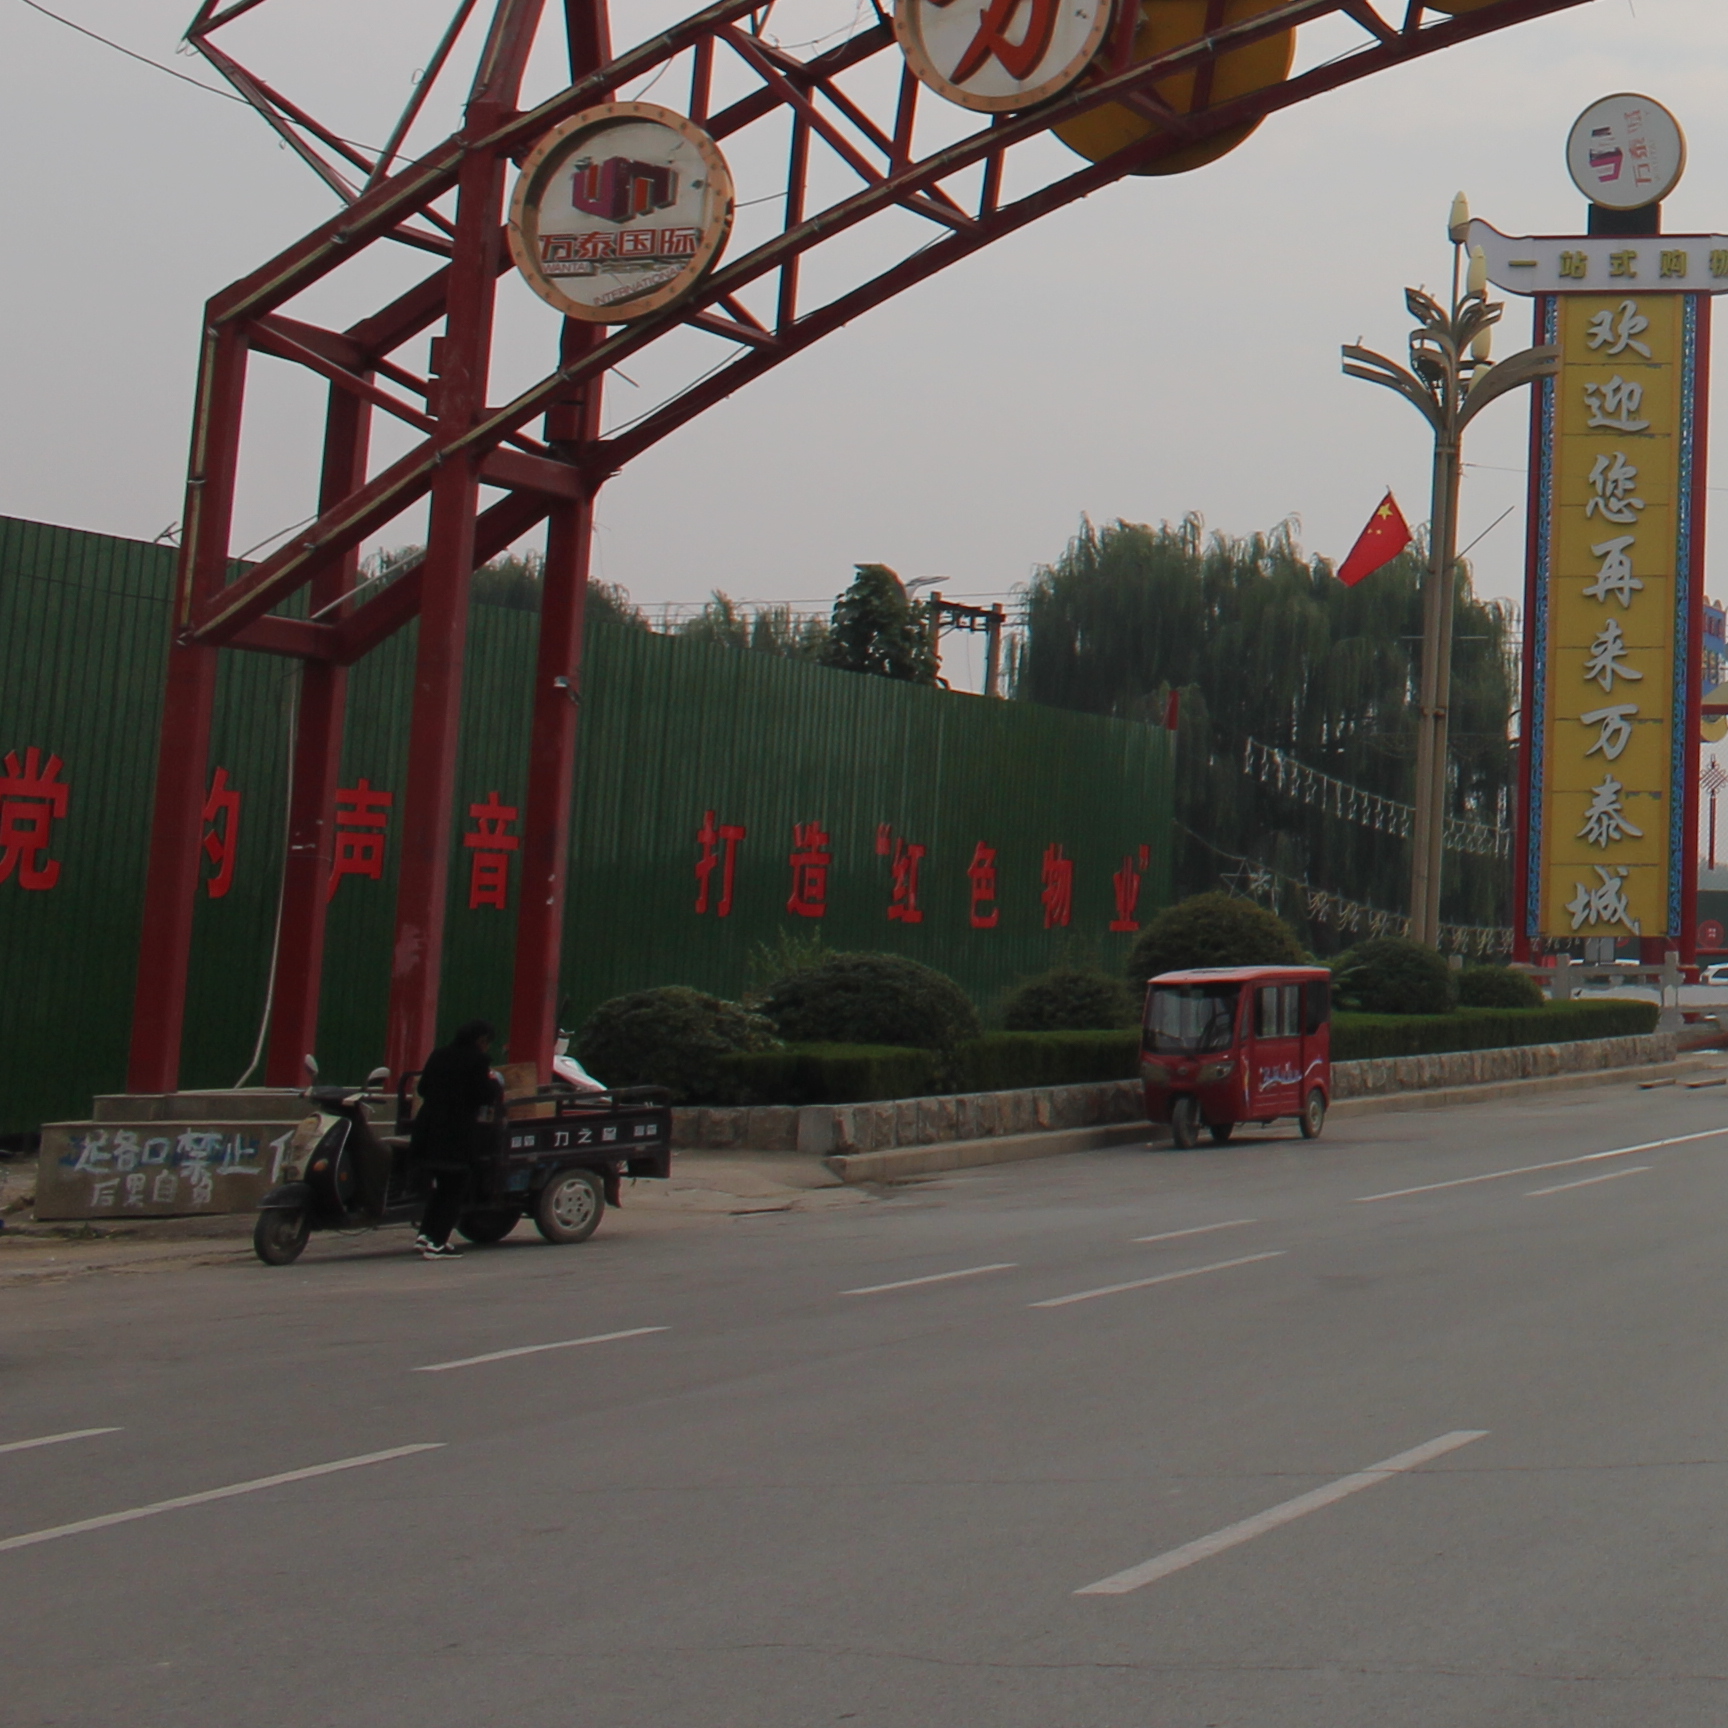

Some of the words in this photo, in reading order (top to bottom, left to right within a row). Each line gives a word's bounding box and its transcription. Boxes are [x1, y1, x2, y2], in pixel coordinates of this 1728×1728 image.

[539, 227, 698, 261] 万泰国际
[1564, 300, 1652, 935] 欢迎您再来万泰城
